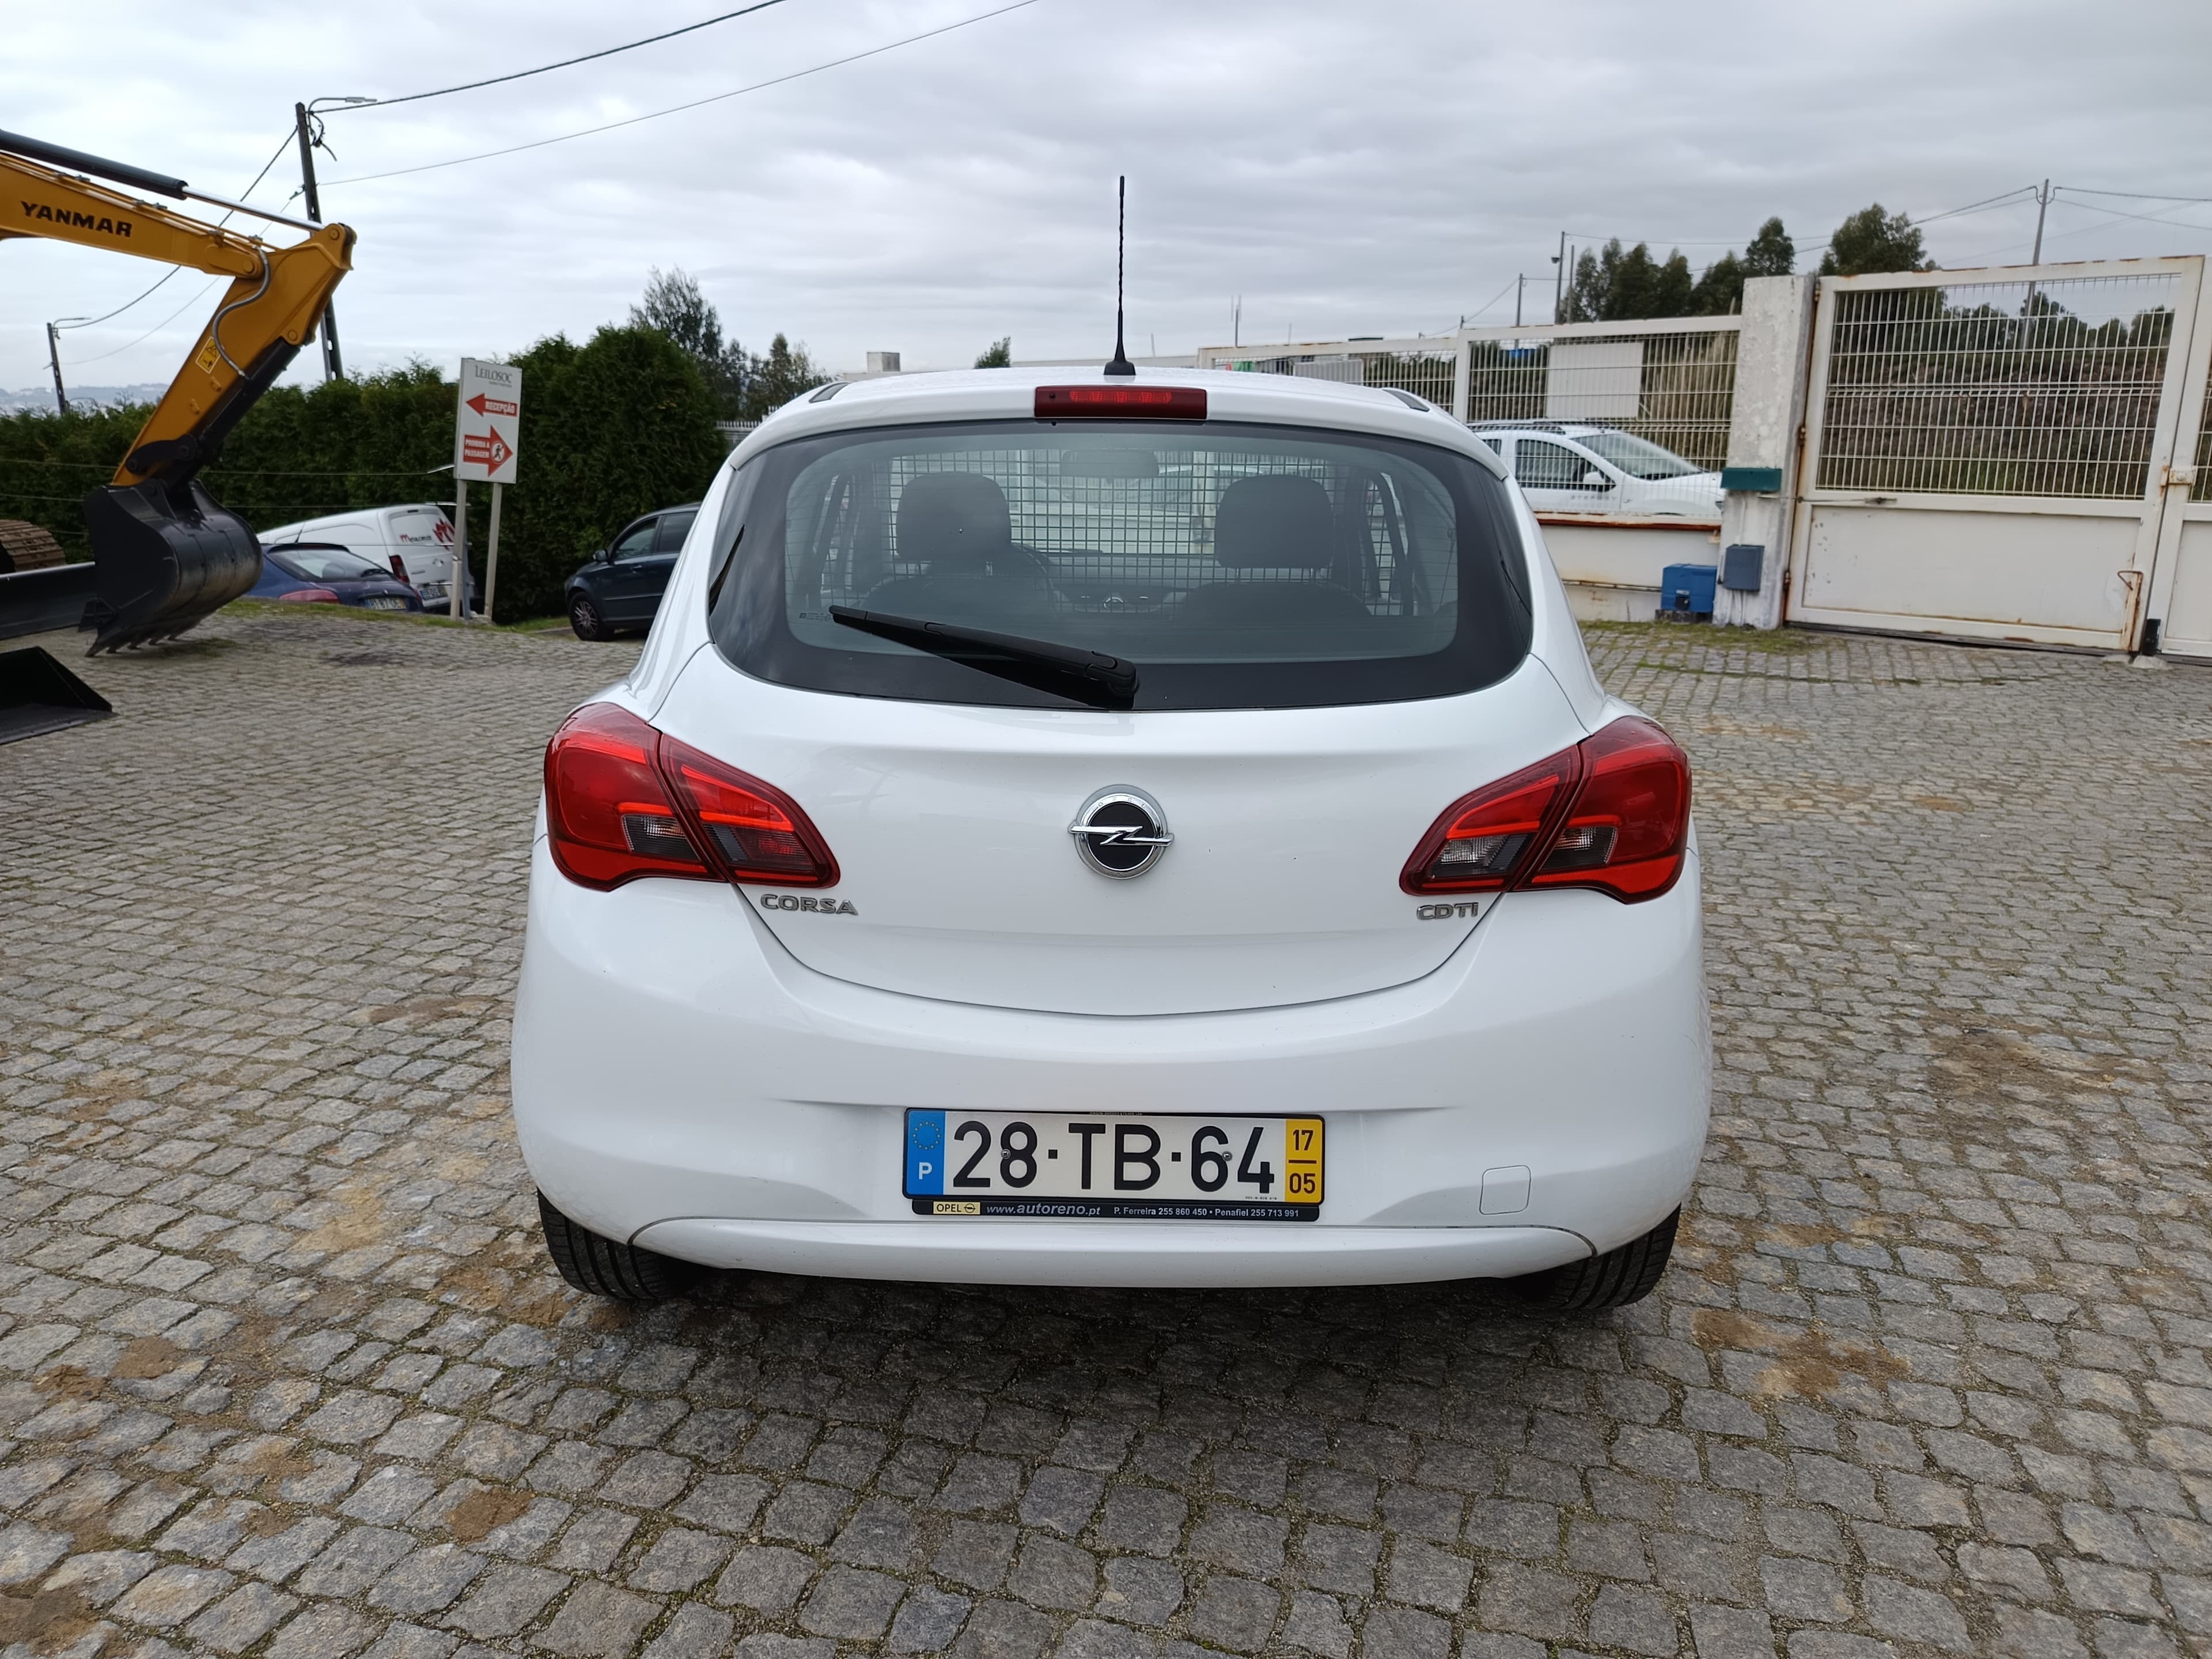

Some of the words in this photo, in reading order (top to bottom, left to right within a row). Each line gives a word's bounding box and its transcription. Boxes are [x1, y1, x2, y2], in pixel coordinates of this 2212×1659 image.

[21, 200, 132, 237] YANMAR
[475, 365, 513, 384] LEILOSOC
[760, 893, 858, 915] CORSA
[1293, 1129, 1314, 1152] 17
[919, 1162, 932, 1180] P
[1289, 1172, 1316, 1195] 05
[936, 1203, 961, 1213] OPEL
[987, 1203, 1101, 1215] www.autoreno.pt
[1114, 1207, 1121, 1215] P.
[1124, 1207, 1156, 1215] Ferreira
[1192, 1208, 1207, 1216] 450
[1215, 1209, 1249, 1217] Penafiel
